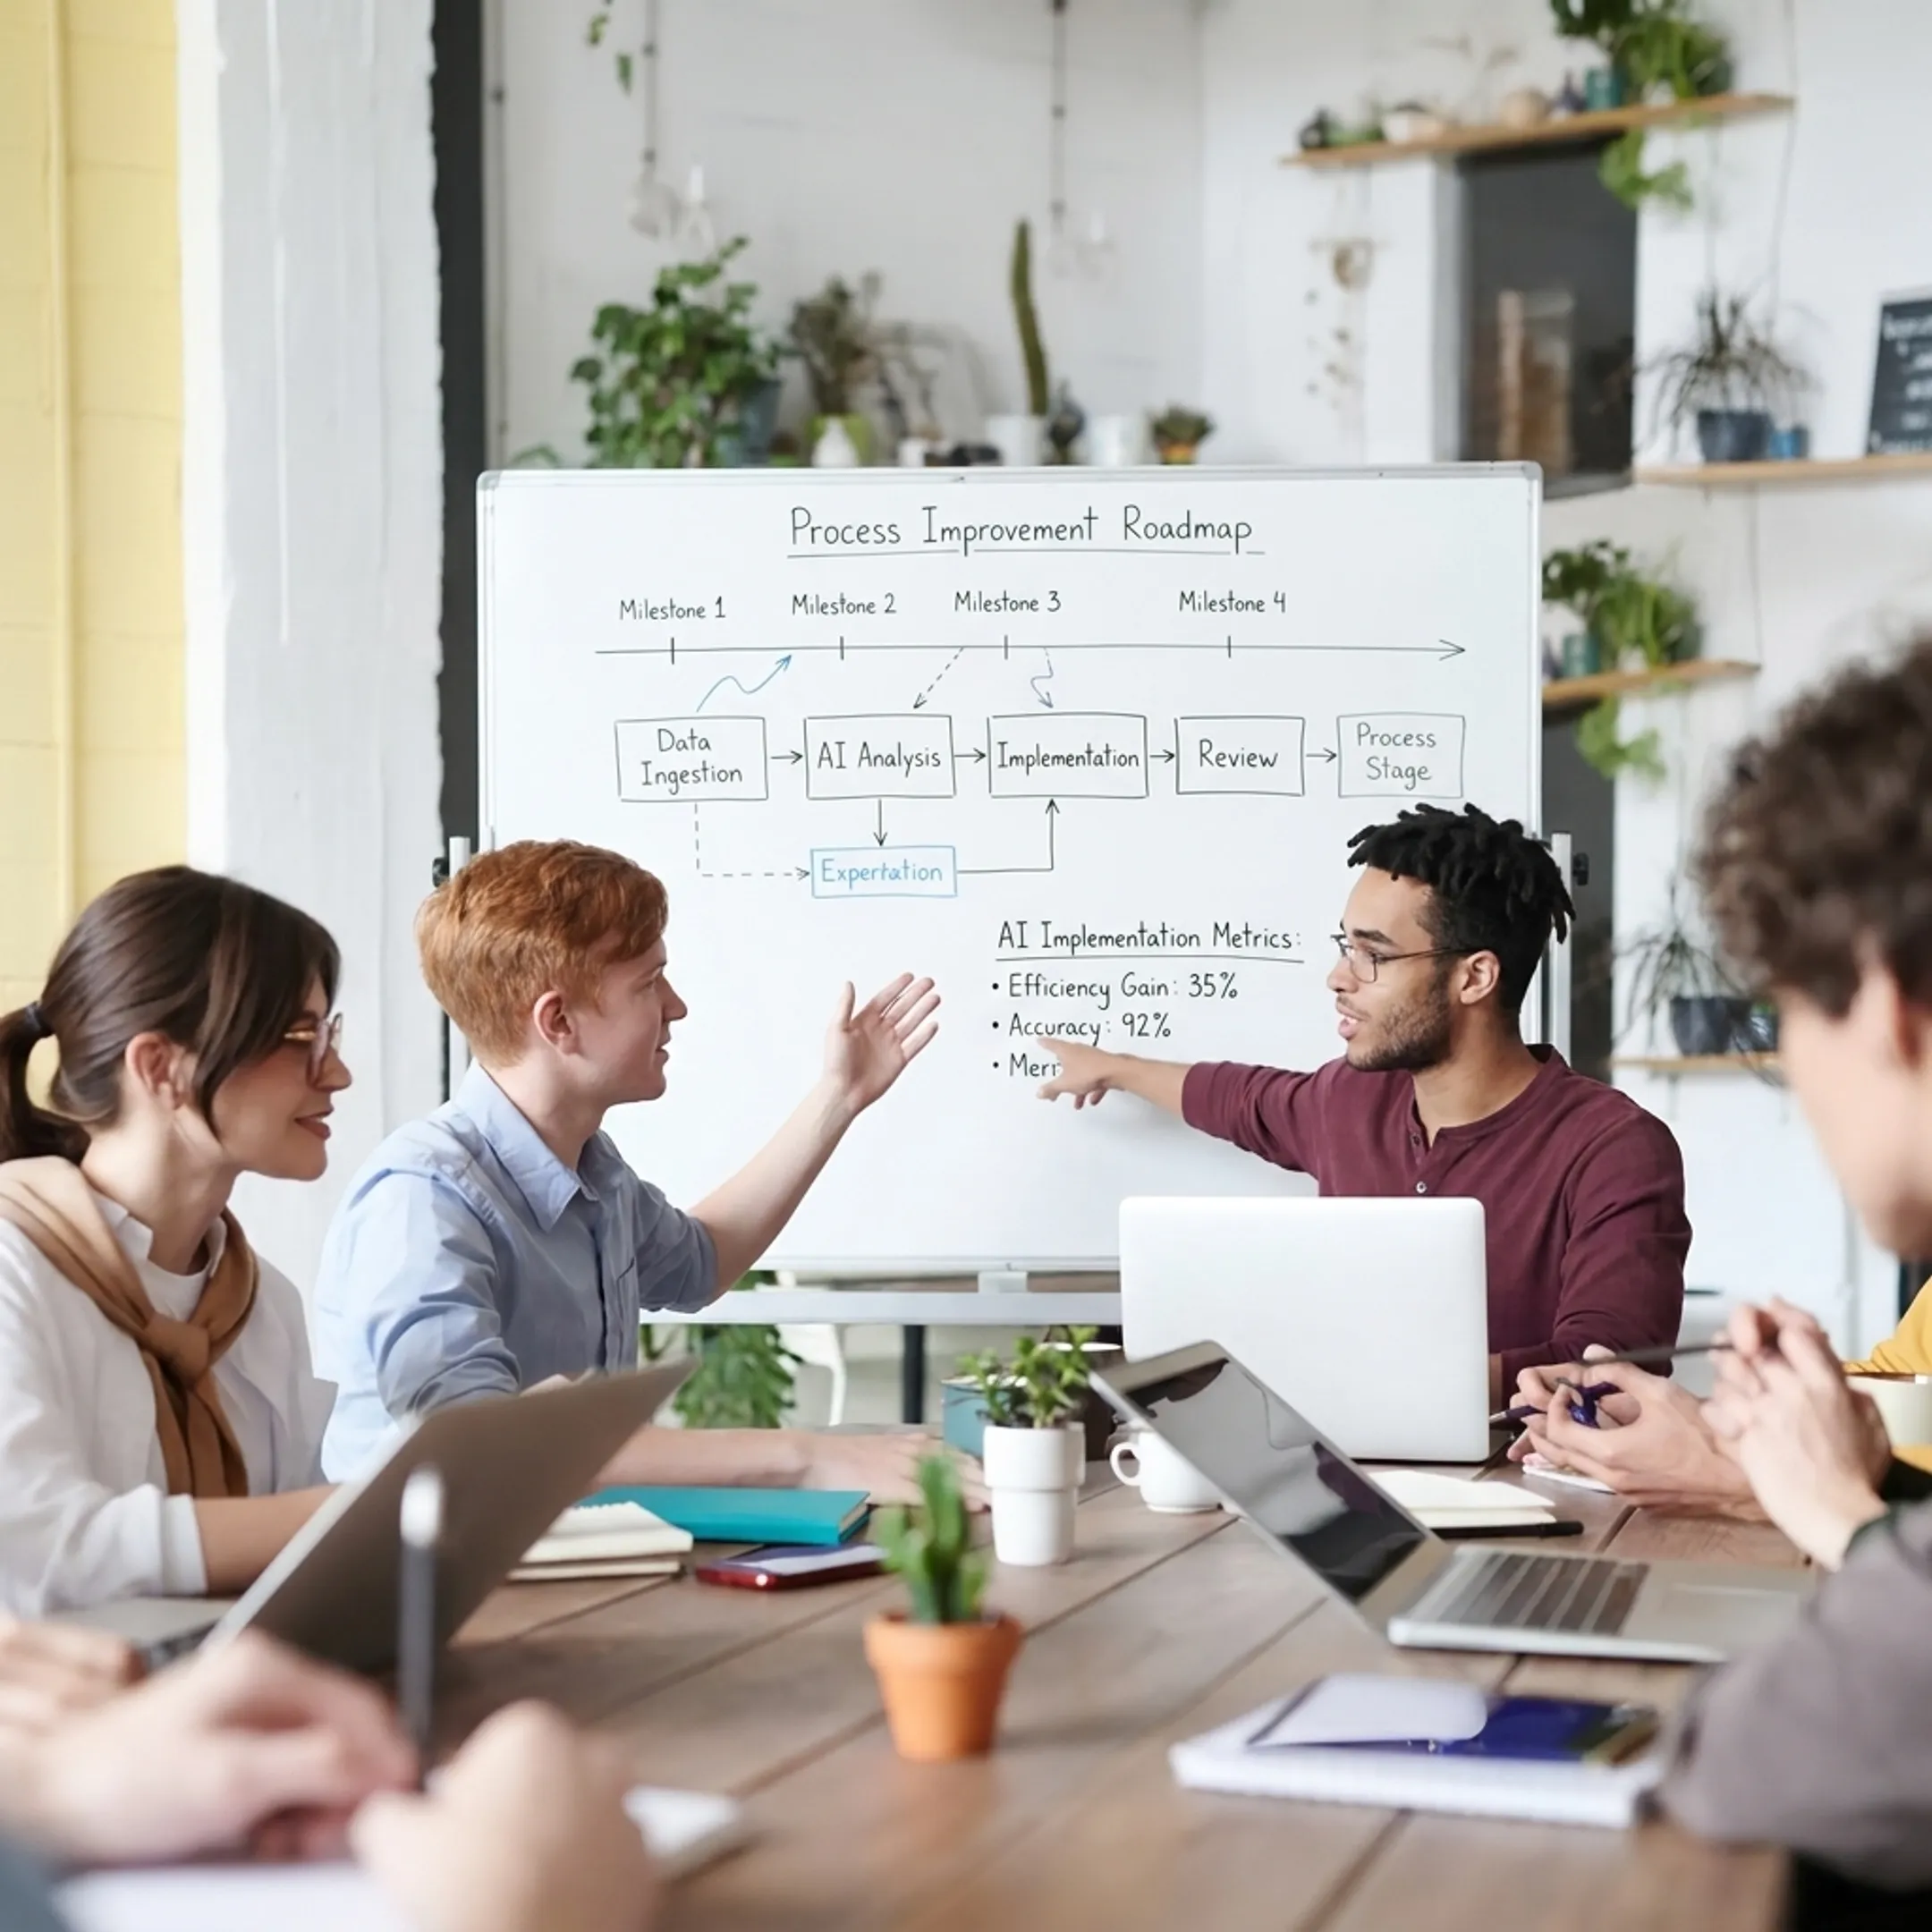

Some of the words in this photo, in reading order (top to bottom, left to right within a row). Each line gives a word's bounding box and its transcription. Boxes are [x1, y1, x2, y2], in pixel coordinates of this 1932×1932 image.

[791, 506, 901, 545] Process
[923, 505, 1098, 556] Improvement
[1123, 504, 1252, 554] Roadmap
[620, 597, 707, 620] Milestone
[716, 596, 725, 618] 1
[792, 592, 876, 615] Milestone
[885, 592, 897, 614] 2
[954, 589, 1039, 612] Milestone
[1047, 590, 1061, 612] 3
[1179, 589, 1265, 613] Milestone
[1274, 590, 1285, 614] 4
[657, 728, 711, 752] Data
[1357, 722, 1436, 748] Process
[818, 741, 847, 769] AI
[858, 741, 941, 778] Analysis
[996, 741, 1140, 776] Implementation
[1199, 738, 1278, 768] Review
[640, 760, 742, 795] Ingestion
[1366, 756, 1432, 791] Stage
[998, 920, 1029, 949] AI
[1041, 920, 1201, 954] Implementation
[1213, 921, 1301, 949] Metrics:
[1009, 972, 1110, 1011] Efficiency
[1121, 971, 1178, 997] Gain:
[1189, 971, 1238, 999] 35%
[1009, 1012, 1111, 1046] Accuracy:
[1122, 1012, 1171, 1038] 92%
